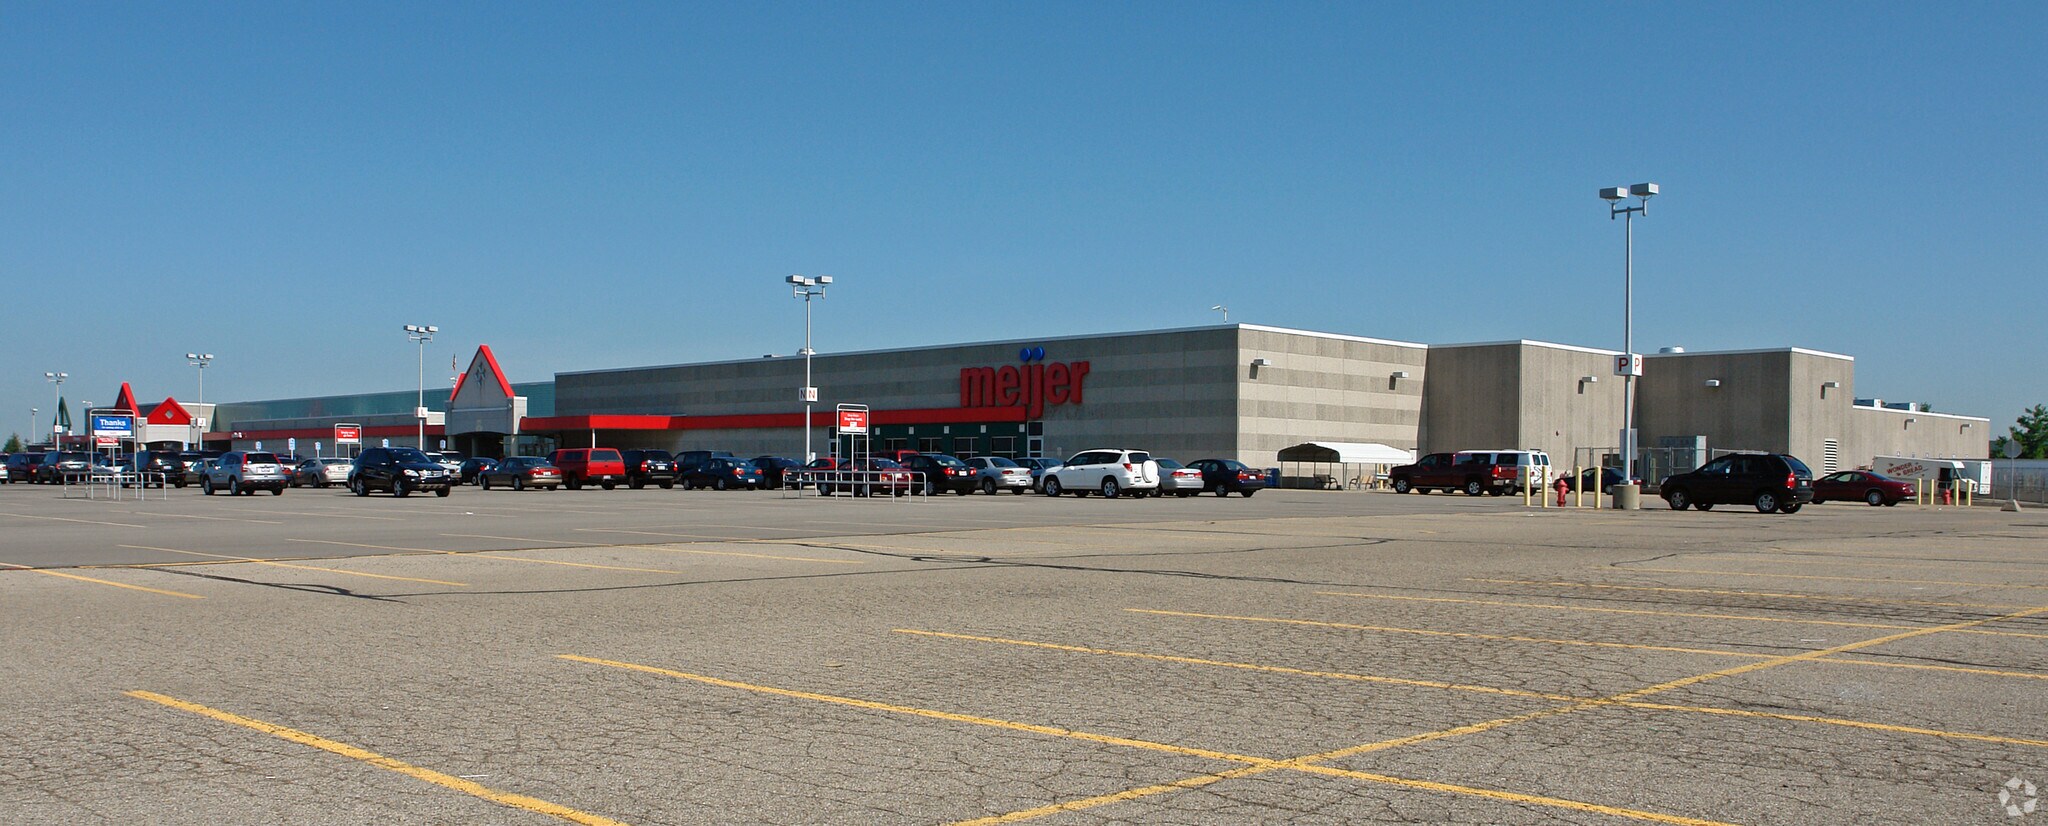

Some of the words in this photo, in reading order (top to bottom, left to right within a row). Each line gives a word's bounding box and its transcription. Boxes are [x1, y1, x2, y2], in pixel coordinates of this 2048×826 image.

[1618, 357, 1629, 372] P
[1634, 357, 1640, 372] P
[960, 346, 1090, 418] meijer
[808, 390, 816, 399] N
[99, 419, 126, 427] Thanks
[1886, 462, 1913, 474] WONDER
[1902, 465, 1923, 475] BREAD
